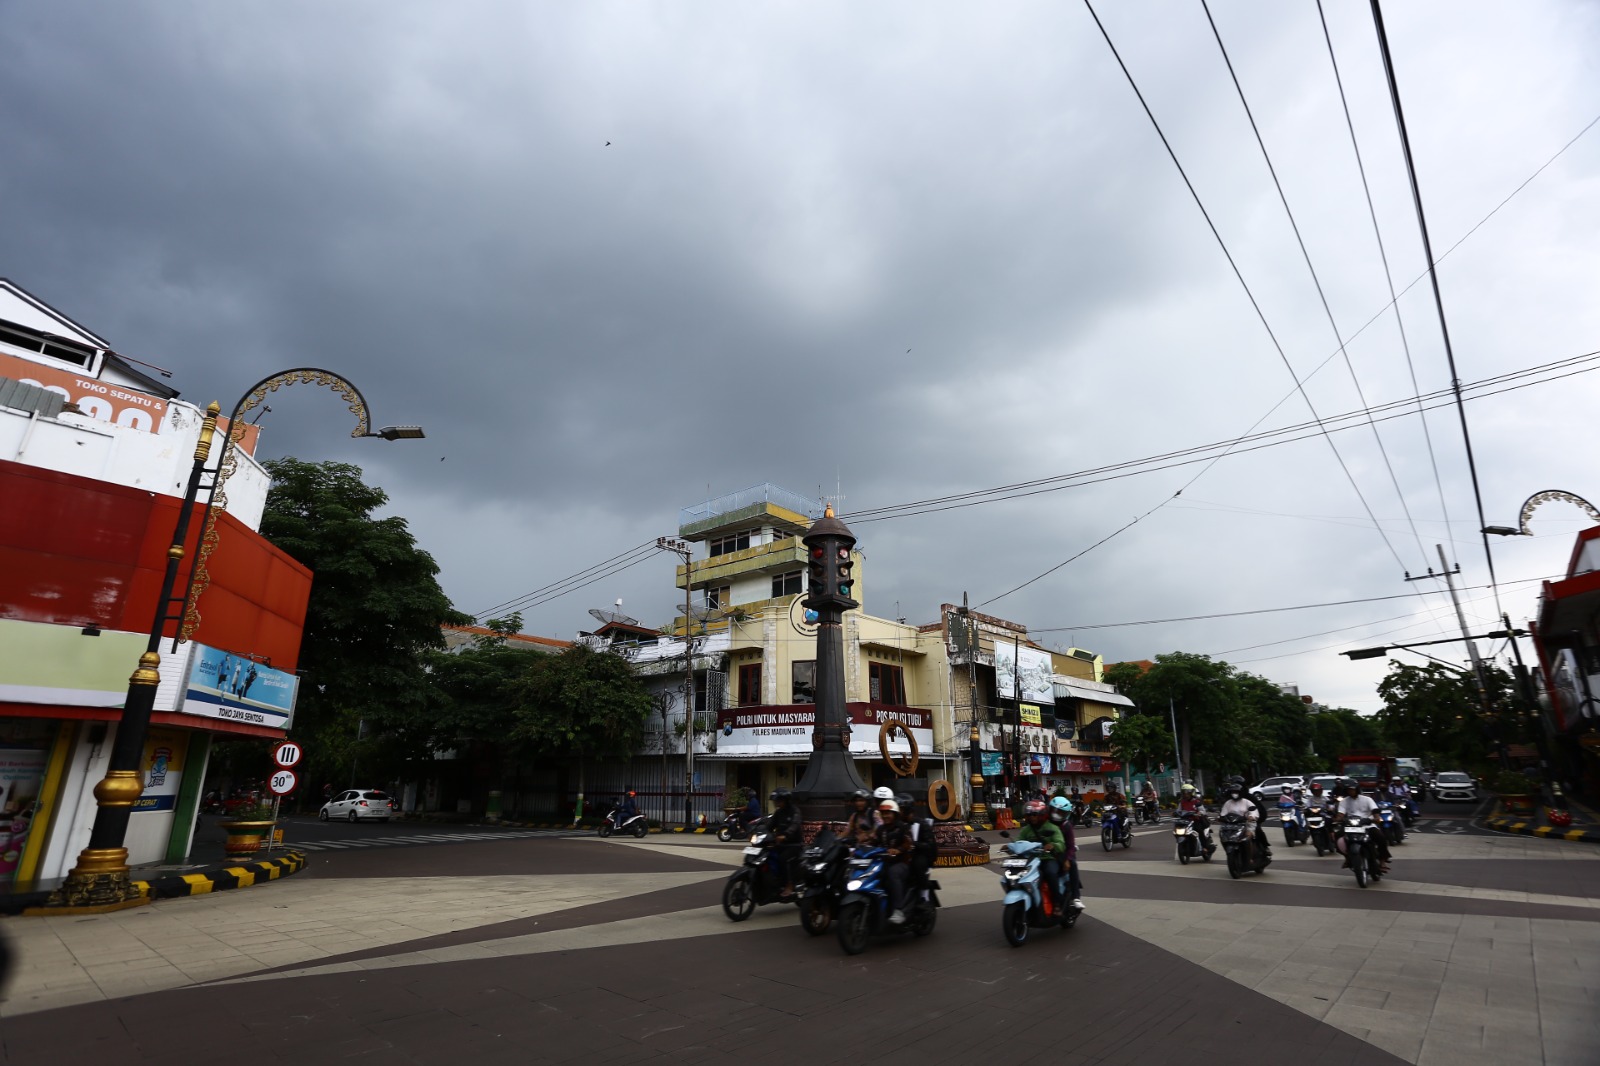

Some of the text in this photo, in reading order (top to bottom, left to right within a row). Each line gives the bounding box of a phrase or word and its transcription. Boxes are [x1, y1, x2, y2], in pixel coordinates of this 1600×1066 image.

[75, 379, 162, 410] TOKO SEPATU &
[218, 708, 264, 723] TOKO JAYA SENTOSA
[736, 714, 753, 726] POLRI
[754, 714, 777, 725] UNTUK
[876, 710, 888, 723] POS
[907, 713, 922, 726] TUGU
[752, 727, 806, 736] POLRES MADIUN KOTA
[273, 776, 286, 787] 30
